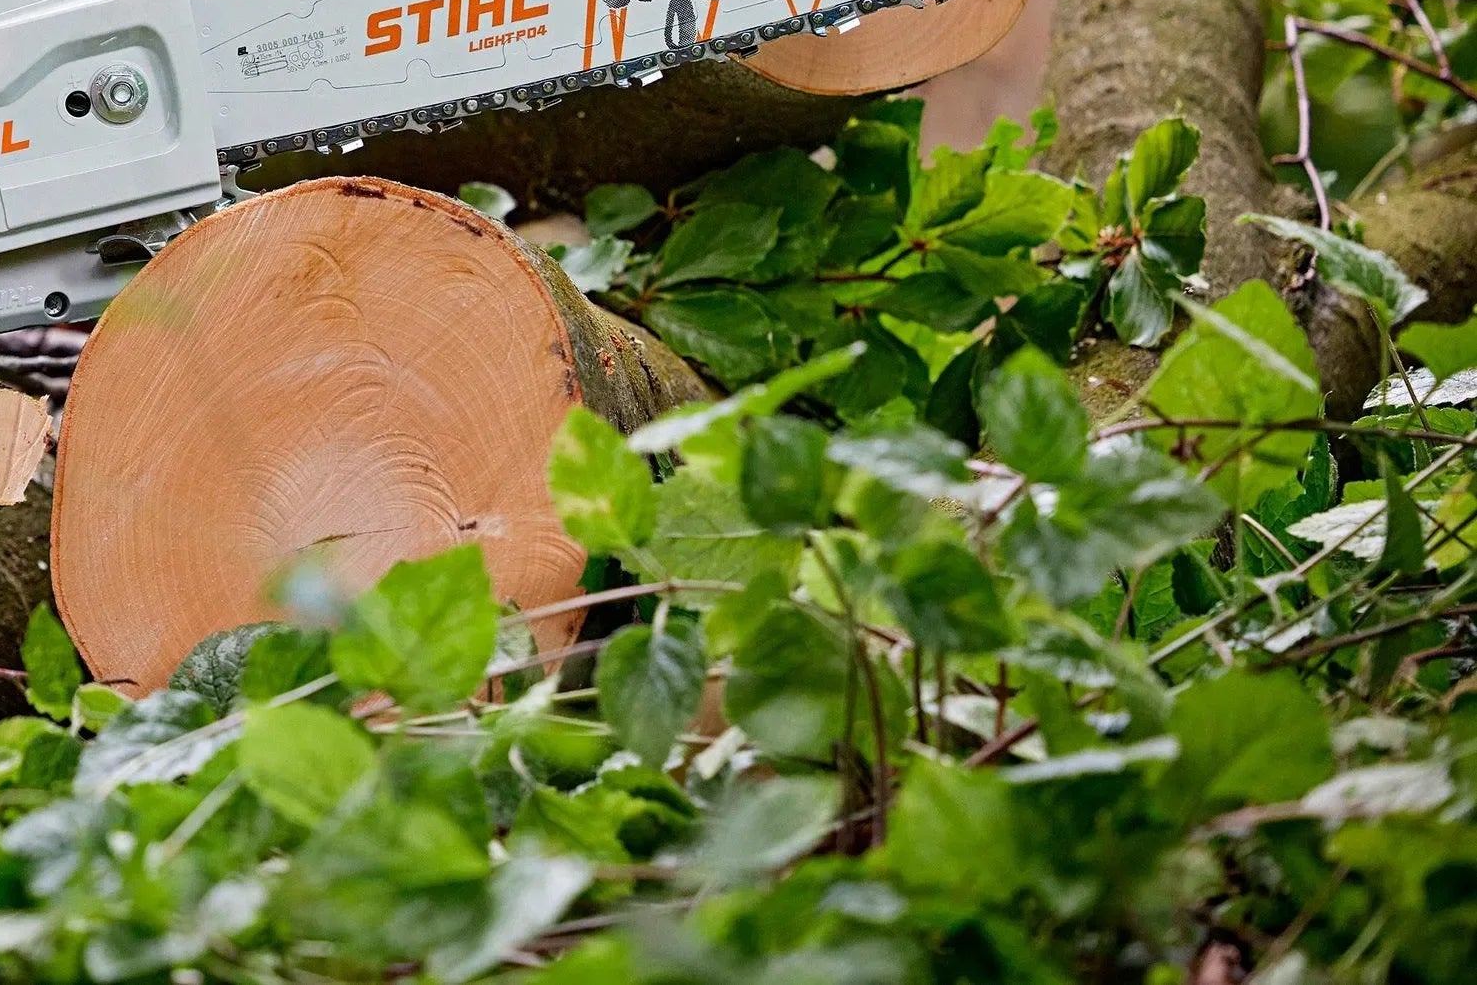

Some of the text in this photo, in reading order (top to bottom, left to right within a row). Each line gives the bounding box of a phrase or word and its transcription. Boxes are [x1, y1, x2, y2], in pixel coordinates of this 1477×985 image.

[256, 41, 279, 54] 3005
[282, 36, 299, 47] 000
[302, 31, 324, 43] 7409
